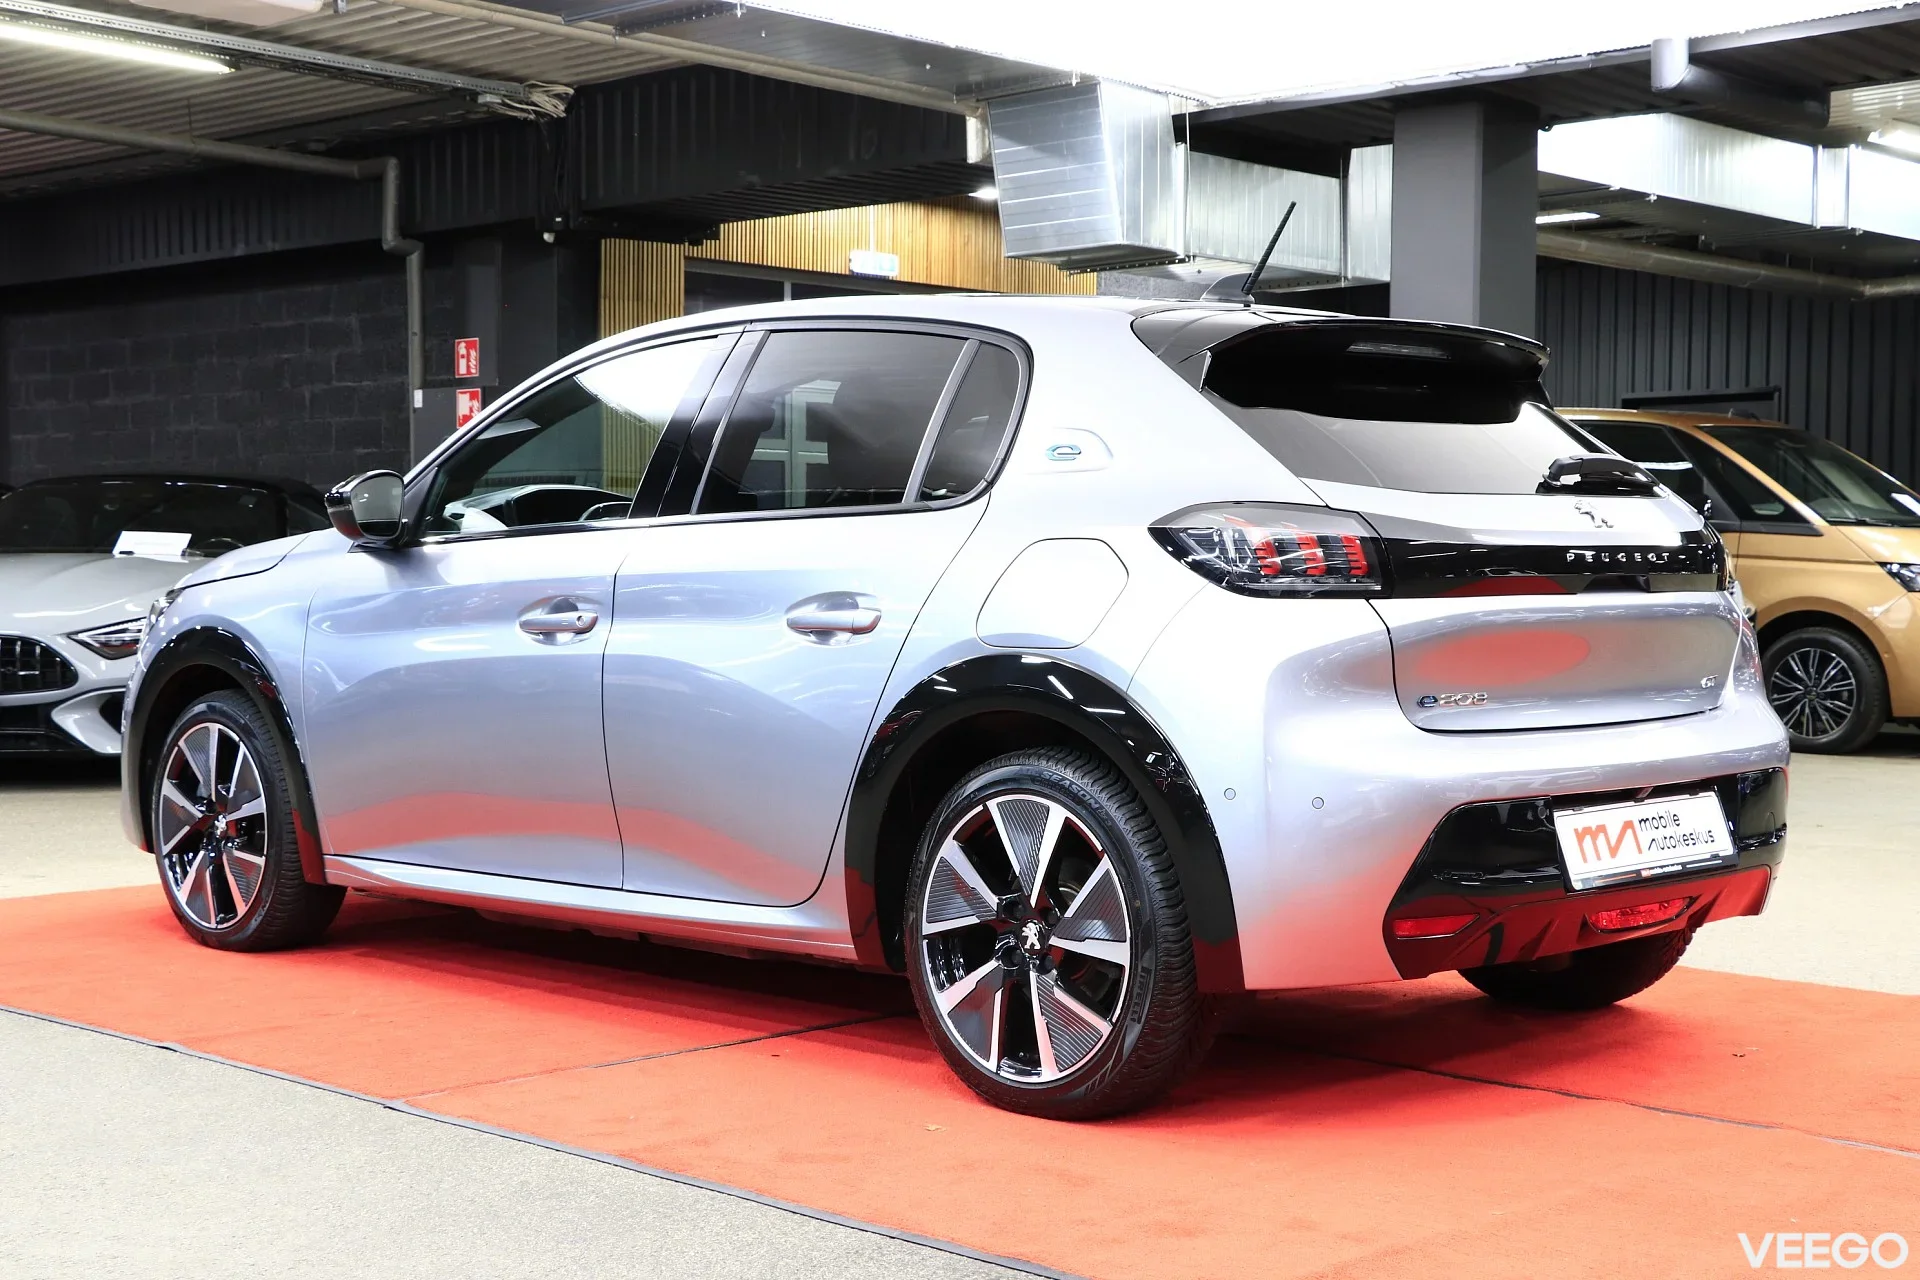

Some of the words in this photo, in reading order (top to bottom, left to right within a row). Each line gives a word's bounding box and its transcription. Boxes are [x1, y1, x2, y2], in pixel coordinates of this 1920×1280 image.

[1045, 443, 1082, 461] e
[1566, 551, 1670, 562] PEUGEOT
[1700, 674, 1719, 689] GT
[1041, 771, 1100, 808] SEASON
[1638, 810, 1681, 832] mobile
